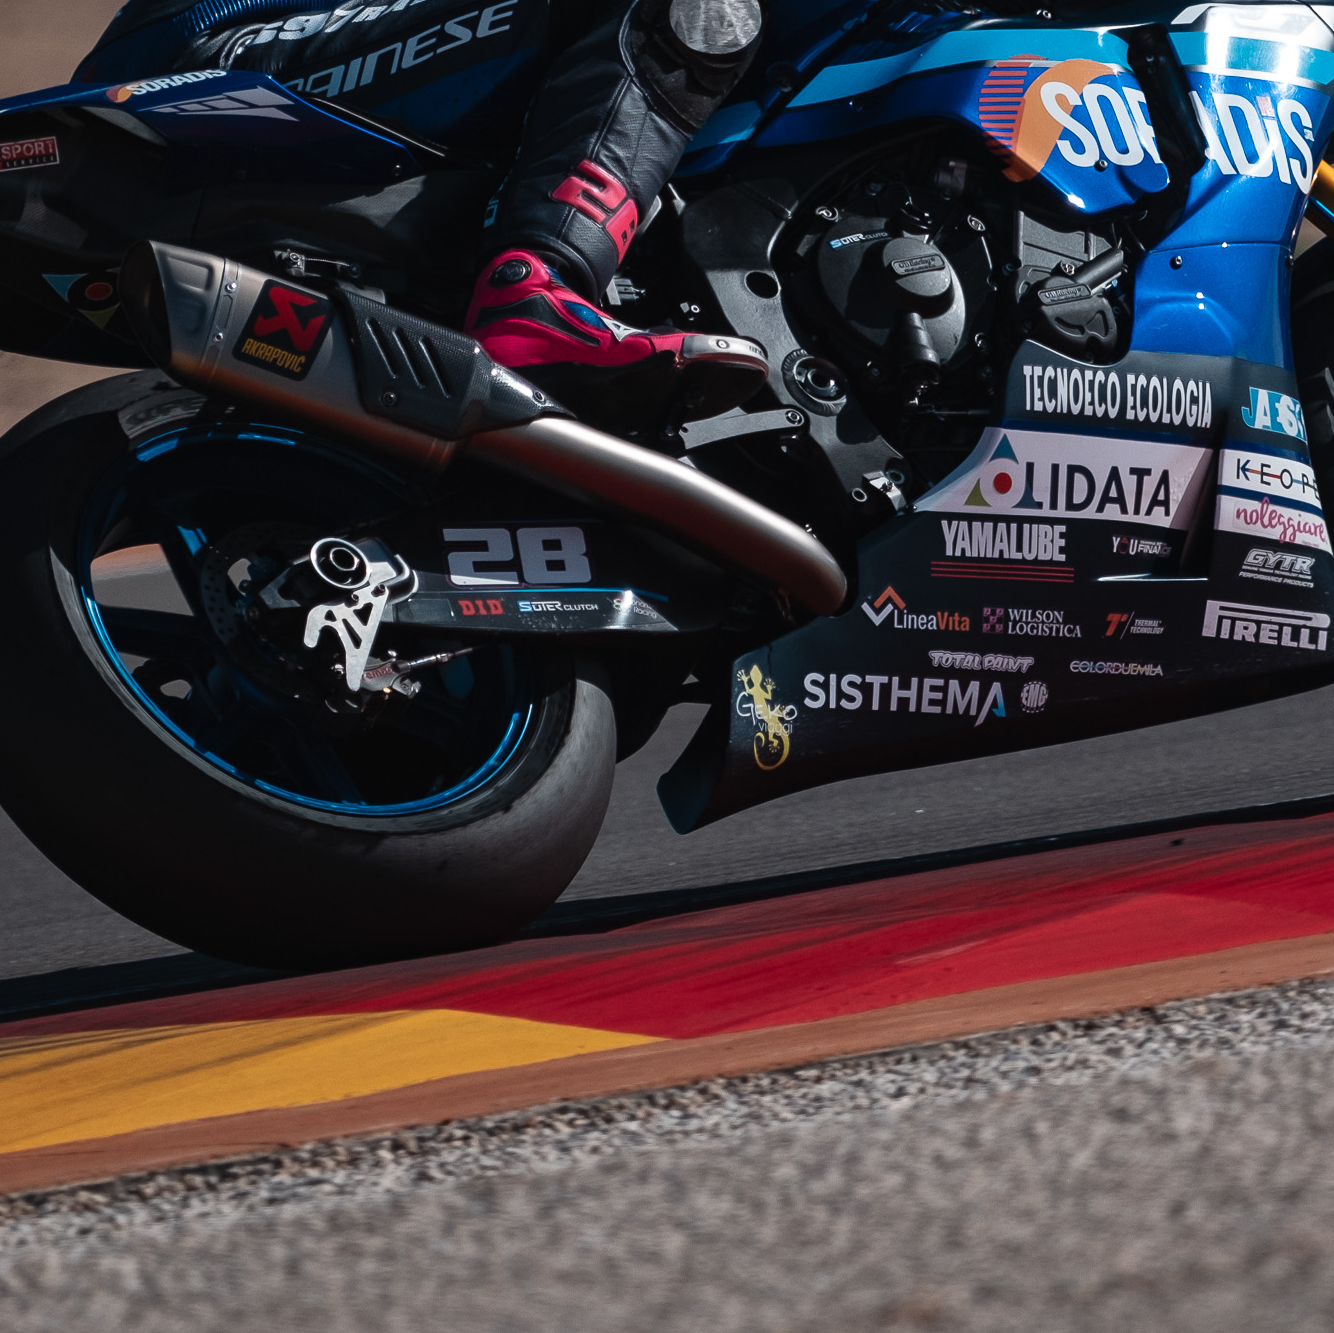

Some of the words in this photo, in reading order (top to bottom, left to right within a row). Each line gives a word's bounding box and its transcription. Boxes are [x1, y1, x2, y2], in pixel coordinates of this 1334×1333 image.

[5, 154, 56, 168] SERVICE
[1023, 365, 1120, 419] TECNOECO
[1125, 372, 1213, 429] ECOLOGIA
[941, 520, 1066, 562] YAMALUBE
[442, 526, 592, 586] 28
[1243, 548, 1316, 575] GYTR
[458, 599, 504, 616] DID
[563, 603, 599, 611] CLUTCH
[1007, 608, 1064, 623] WILSON
[1007, 622, 1082, 638] LOGISTICA
[1201, 599, 1331, 651] PIRELLI
[929, 650, 982, 670] TOTAL
[982, 654, 1034, 674] PAINT
[803, 672, 1006, 728] SISTHEMA
